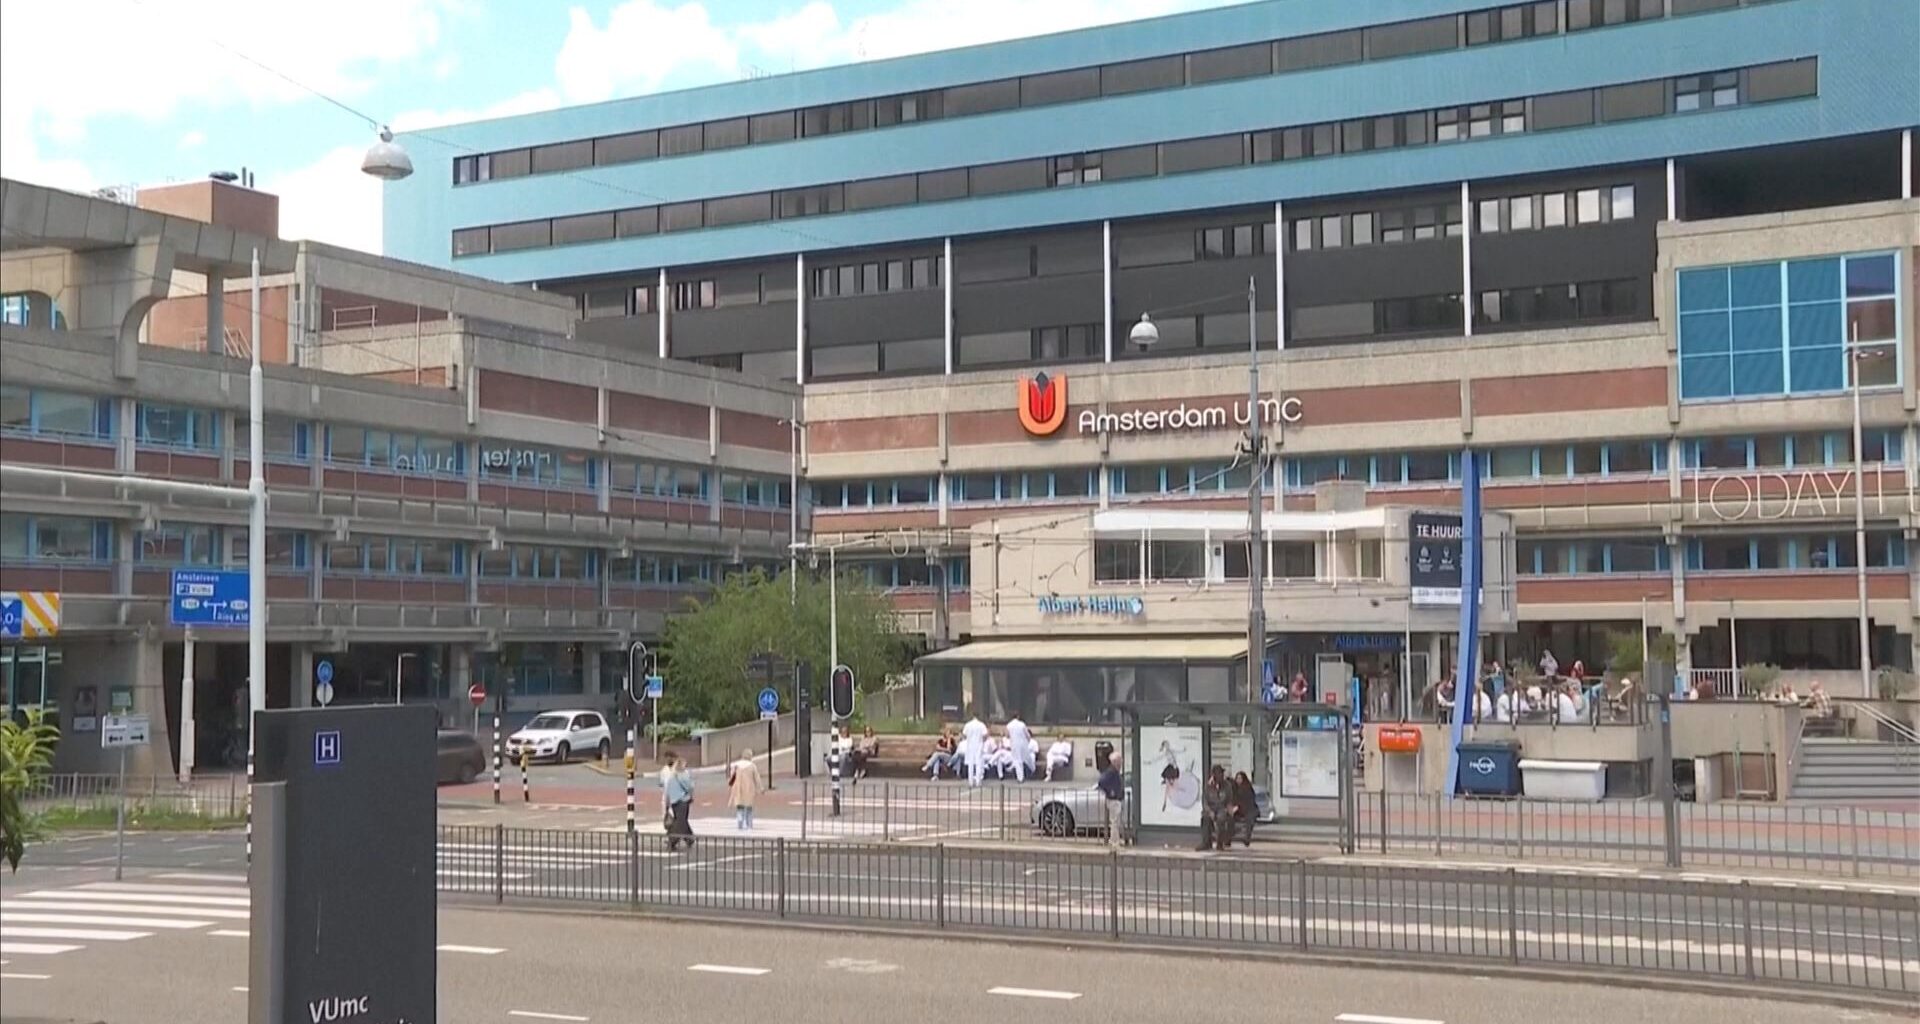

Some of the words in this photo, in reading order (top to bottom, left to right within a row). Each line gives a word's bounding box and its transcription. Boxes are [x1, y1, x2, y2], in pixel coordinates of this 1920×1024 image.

[1078, 402, 1226, 433] Amsterdam
[1680, 465, 1852, 520] TODAY
[1416, 524, 1430, 538] TE
[1431, 525, 1462, 539] HUUR
[176, 573, 220, 582] Amstelveen
[1039, 595, 1087, 615] Albert
[321, 737, 335, 758] H
[309, 995, 369, 1023] VUmc
